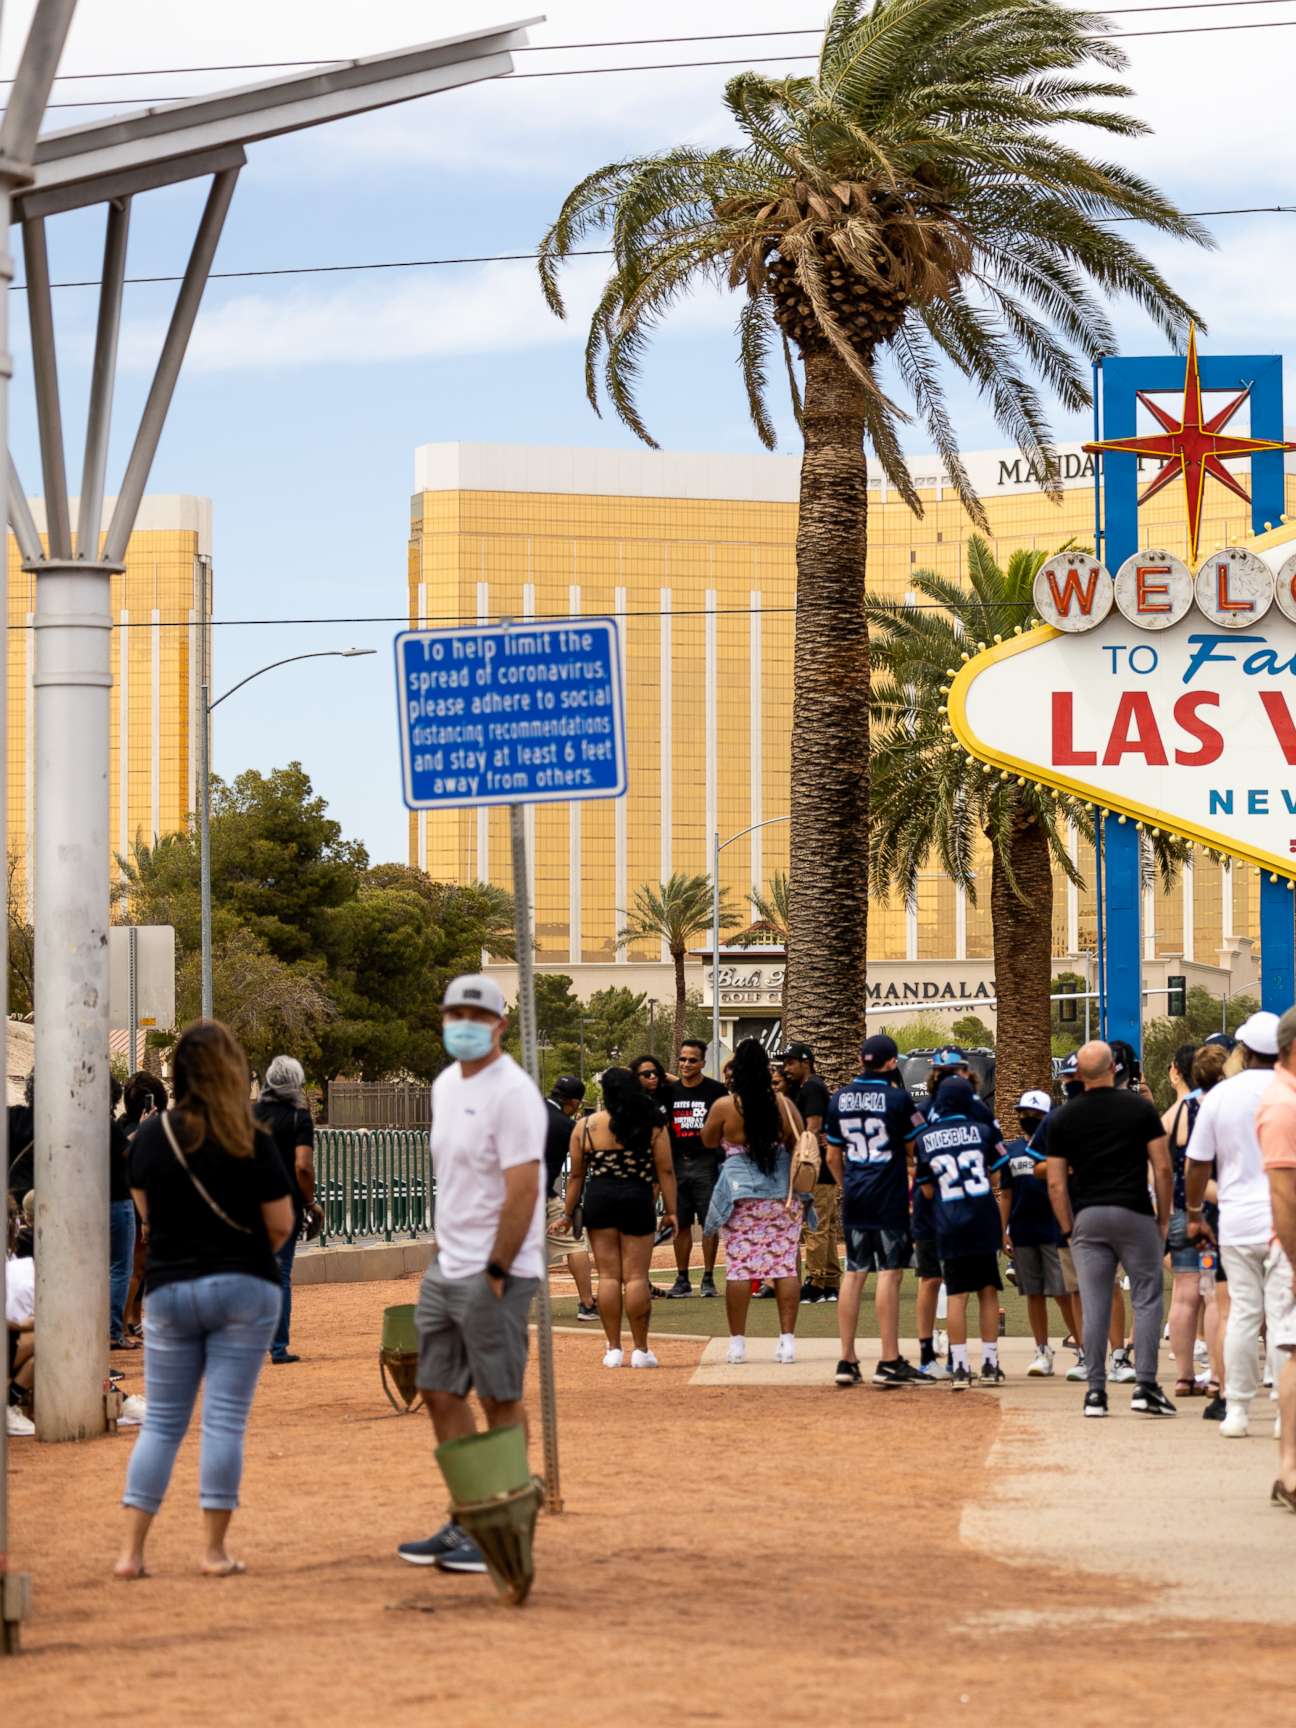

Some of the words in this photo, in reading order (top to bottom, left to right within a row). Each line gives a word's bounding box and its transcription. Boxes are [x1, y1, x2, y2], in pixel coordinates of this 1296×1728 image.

[420, 639, 444, 661] To
[452, 636, 497, 664] help
[503, 632, 552, 656] limit
[559, 631, 593, 653] the
[1102, 645, 1159, 675] TO
[409, 666, 470, 694] spread
[475, 663, 493, 686] of
[409, 695, 465, 724] please
[471, 690, 531, 715] adhere
[536, 689, 556, 710] to
[560, 684, 611, 708] social
[411, 723, 485, 748] distancing
[488, 715, 611, 741] recommendations
[1052, 690, 1225, 767] LAS
[414, 750, 444, 772] and
[450, 748, 487, 773] stay
[493, 745, 510, 767] at
[517, 742, 557, 765] least
[563, 741, 576, 762] 6
[580, 738, 613, 761] feet
[433, 776, 480, 797] away
[486, 770, 528, 790] from
[838, 1117, 892, 1164] 52
[922, 1126, 982, 1153] NIEBLA
[929, 1149, 990, 1203] 23
